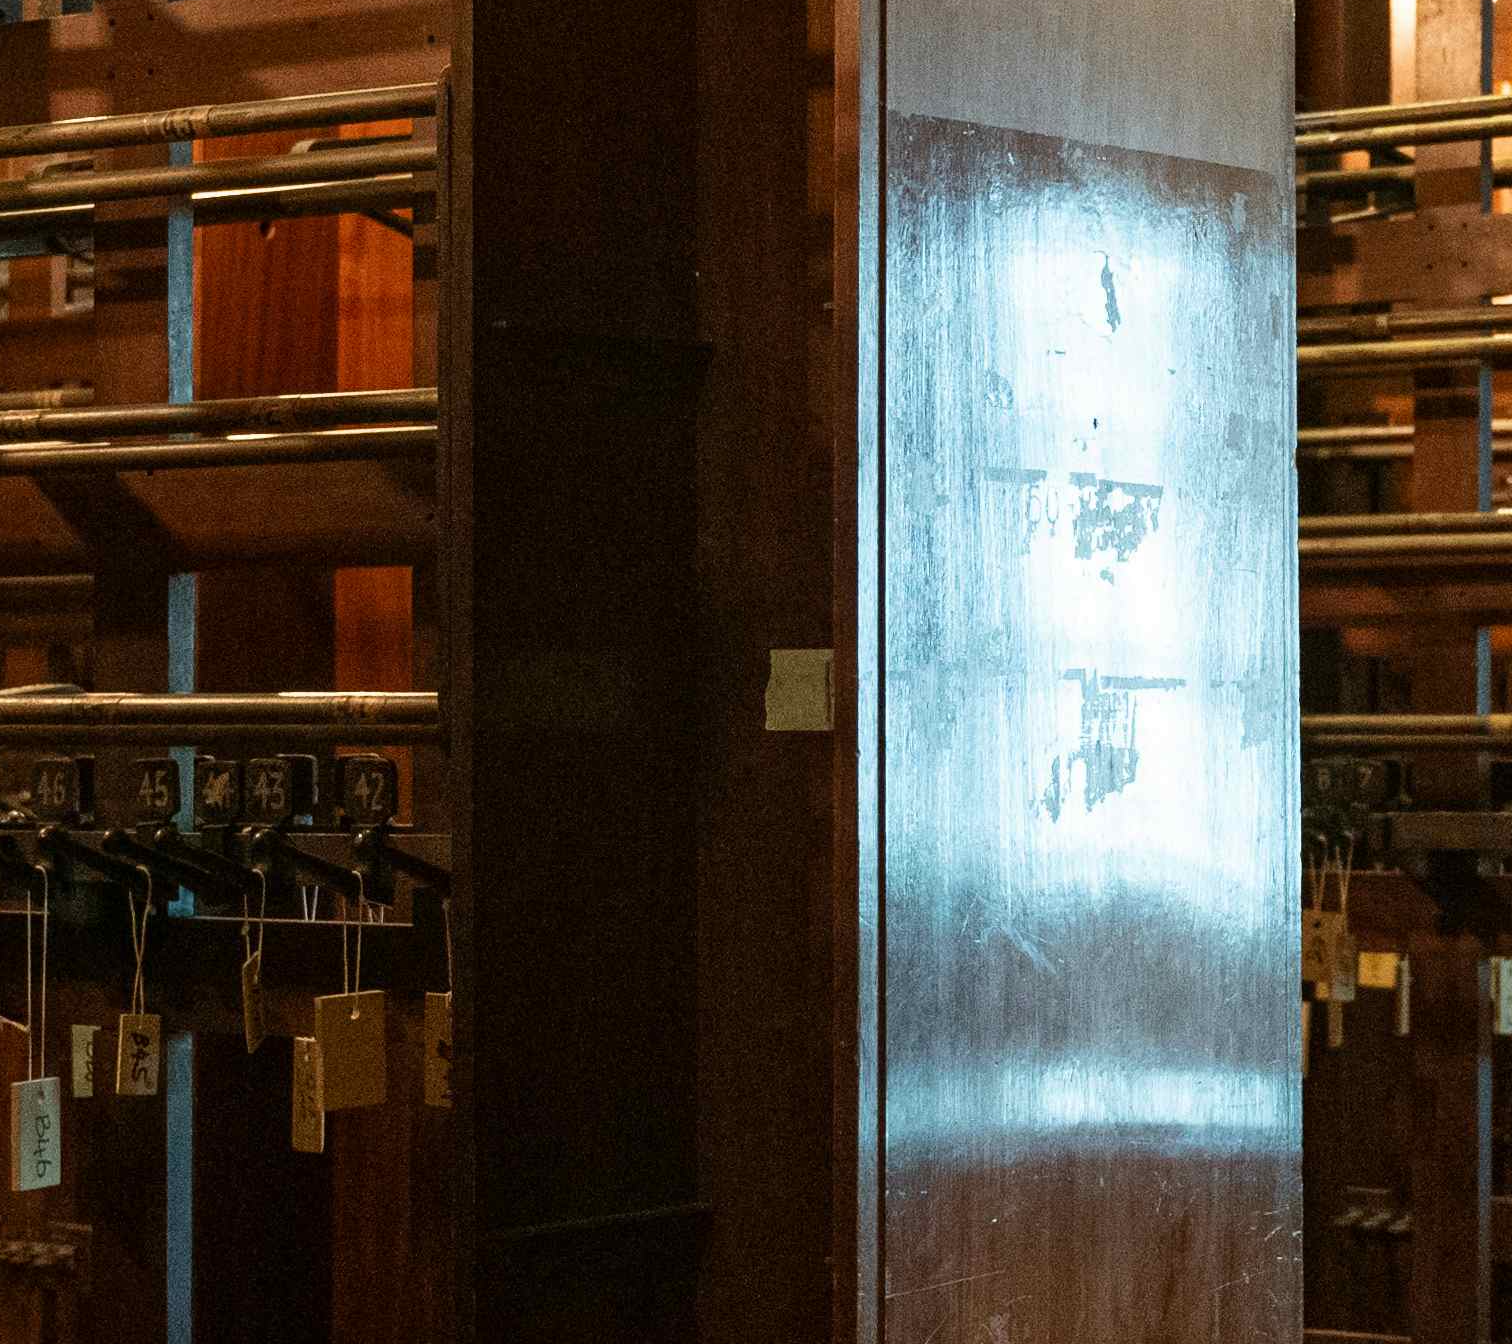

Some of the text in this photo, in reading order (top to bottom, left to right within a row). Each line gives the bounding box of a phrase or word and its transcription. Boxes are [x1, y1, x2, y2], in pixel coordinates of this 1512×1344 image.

[38, 771, 67, 805] 46
[139, 769, 169, 807] 45
[254, 770, 285, 809] 43
[354, 772, 384, 811] 42
